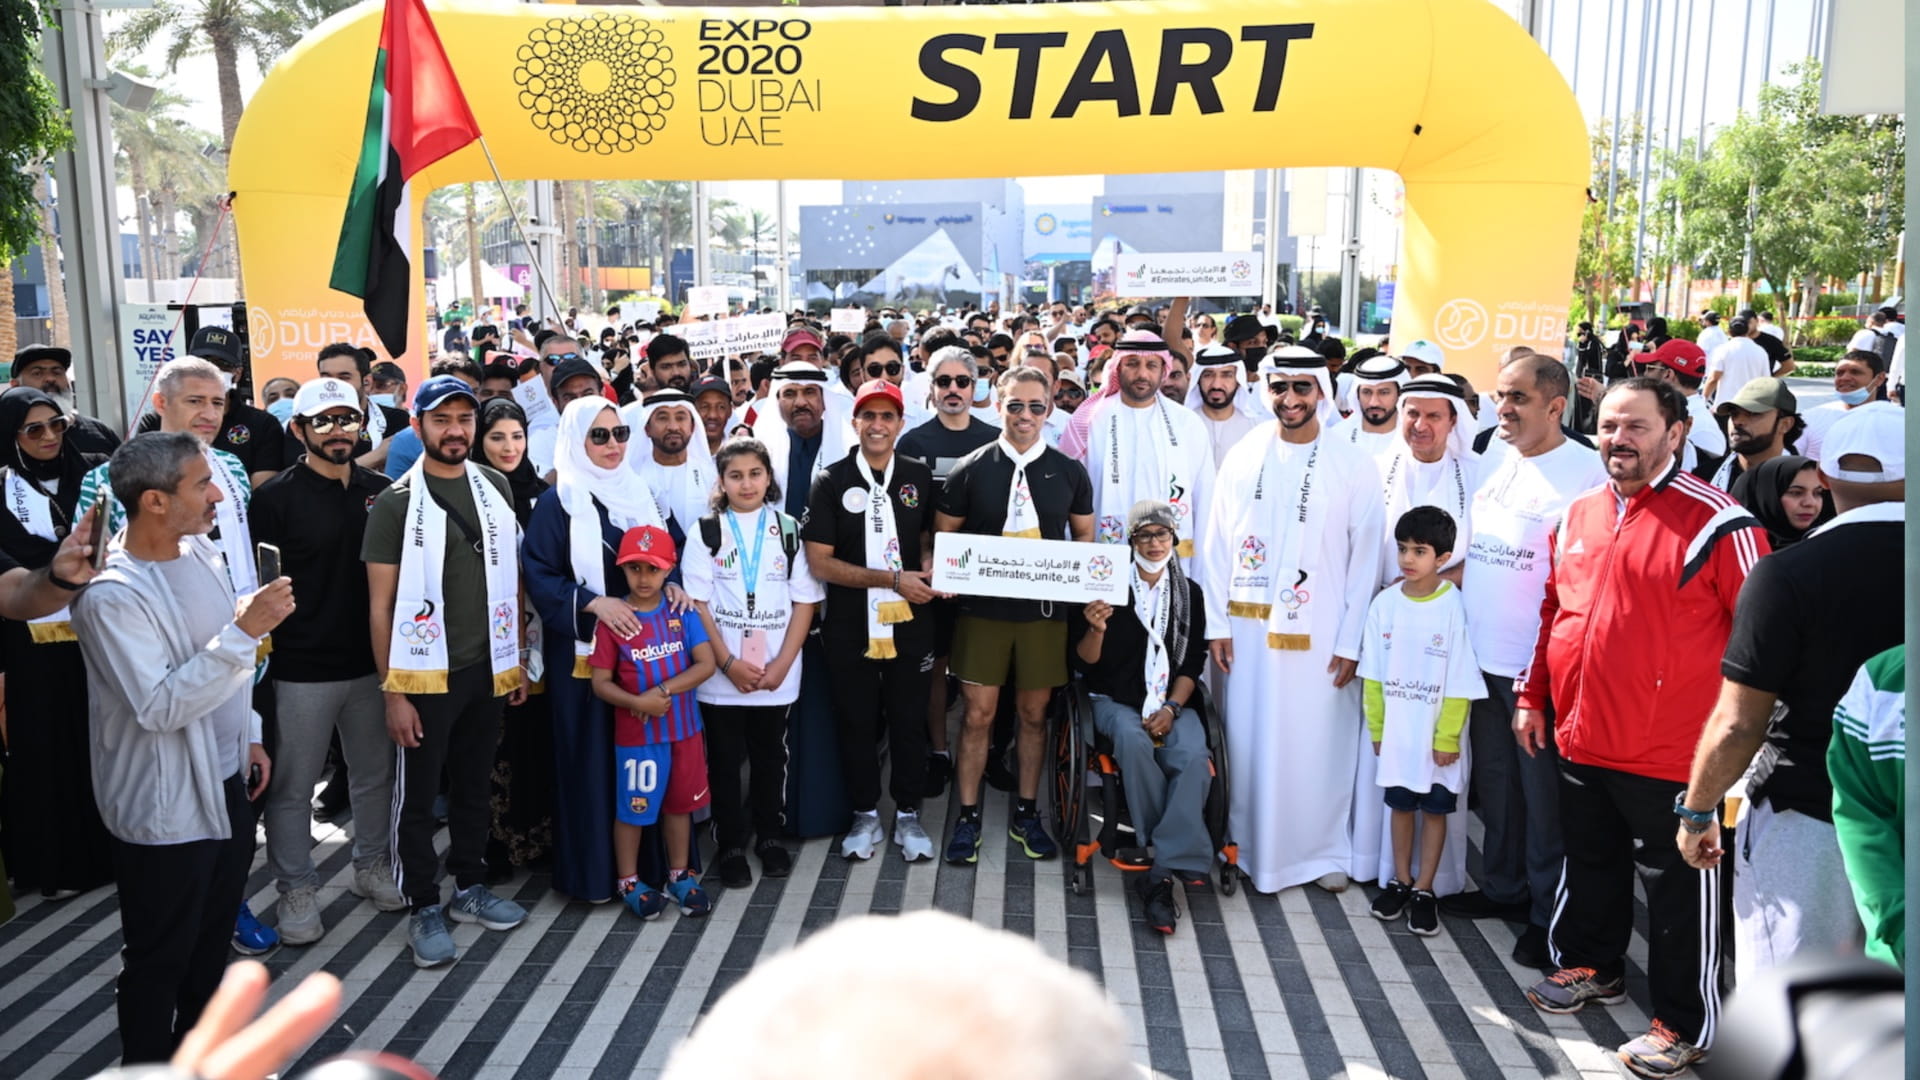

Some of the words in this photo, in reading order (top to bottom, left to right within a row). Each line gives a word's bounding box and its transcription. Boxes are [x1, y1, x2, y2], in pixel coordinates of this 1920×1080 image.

[699, 19, 812, 41] EXPO
[697, 44, 803, 75] 2020
[911, 23, 1315, 122] START
[698, 79, 821, 112] DUBAI
[700, 116, 784, 146] UAE
[1151, 275, 1227, 284] #Emirates_unite_us
[133, 328, 174, 345] SAY
[134, 346, 176, 362] YES
[978, 567, 1080, 584] #Emirates_unite_us
[410, 647, 430, 656] UAE
[631, 641, 684, 662] Rakuten
[624, 758, 657, 793] 10
